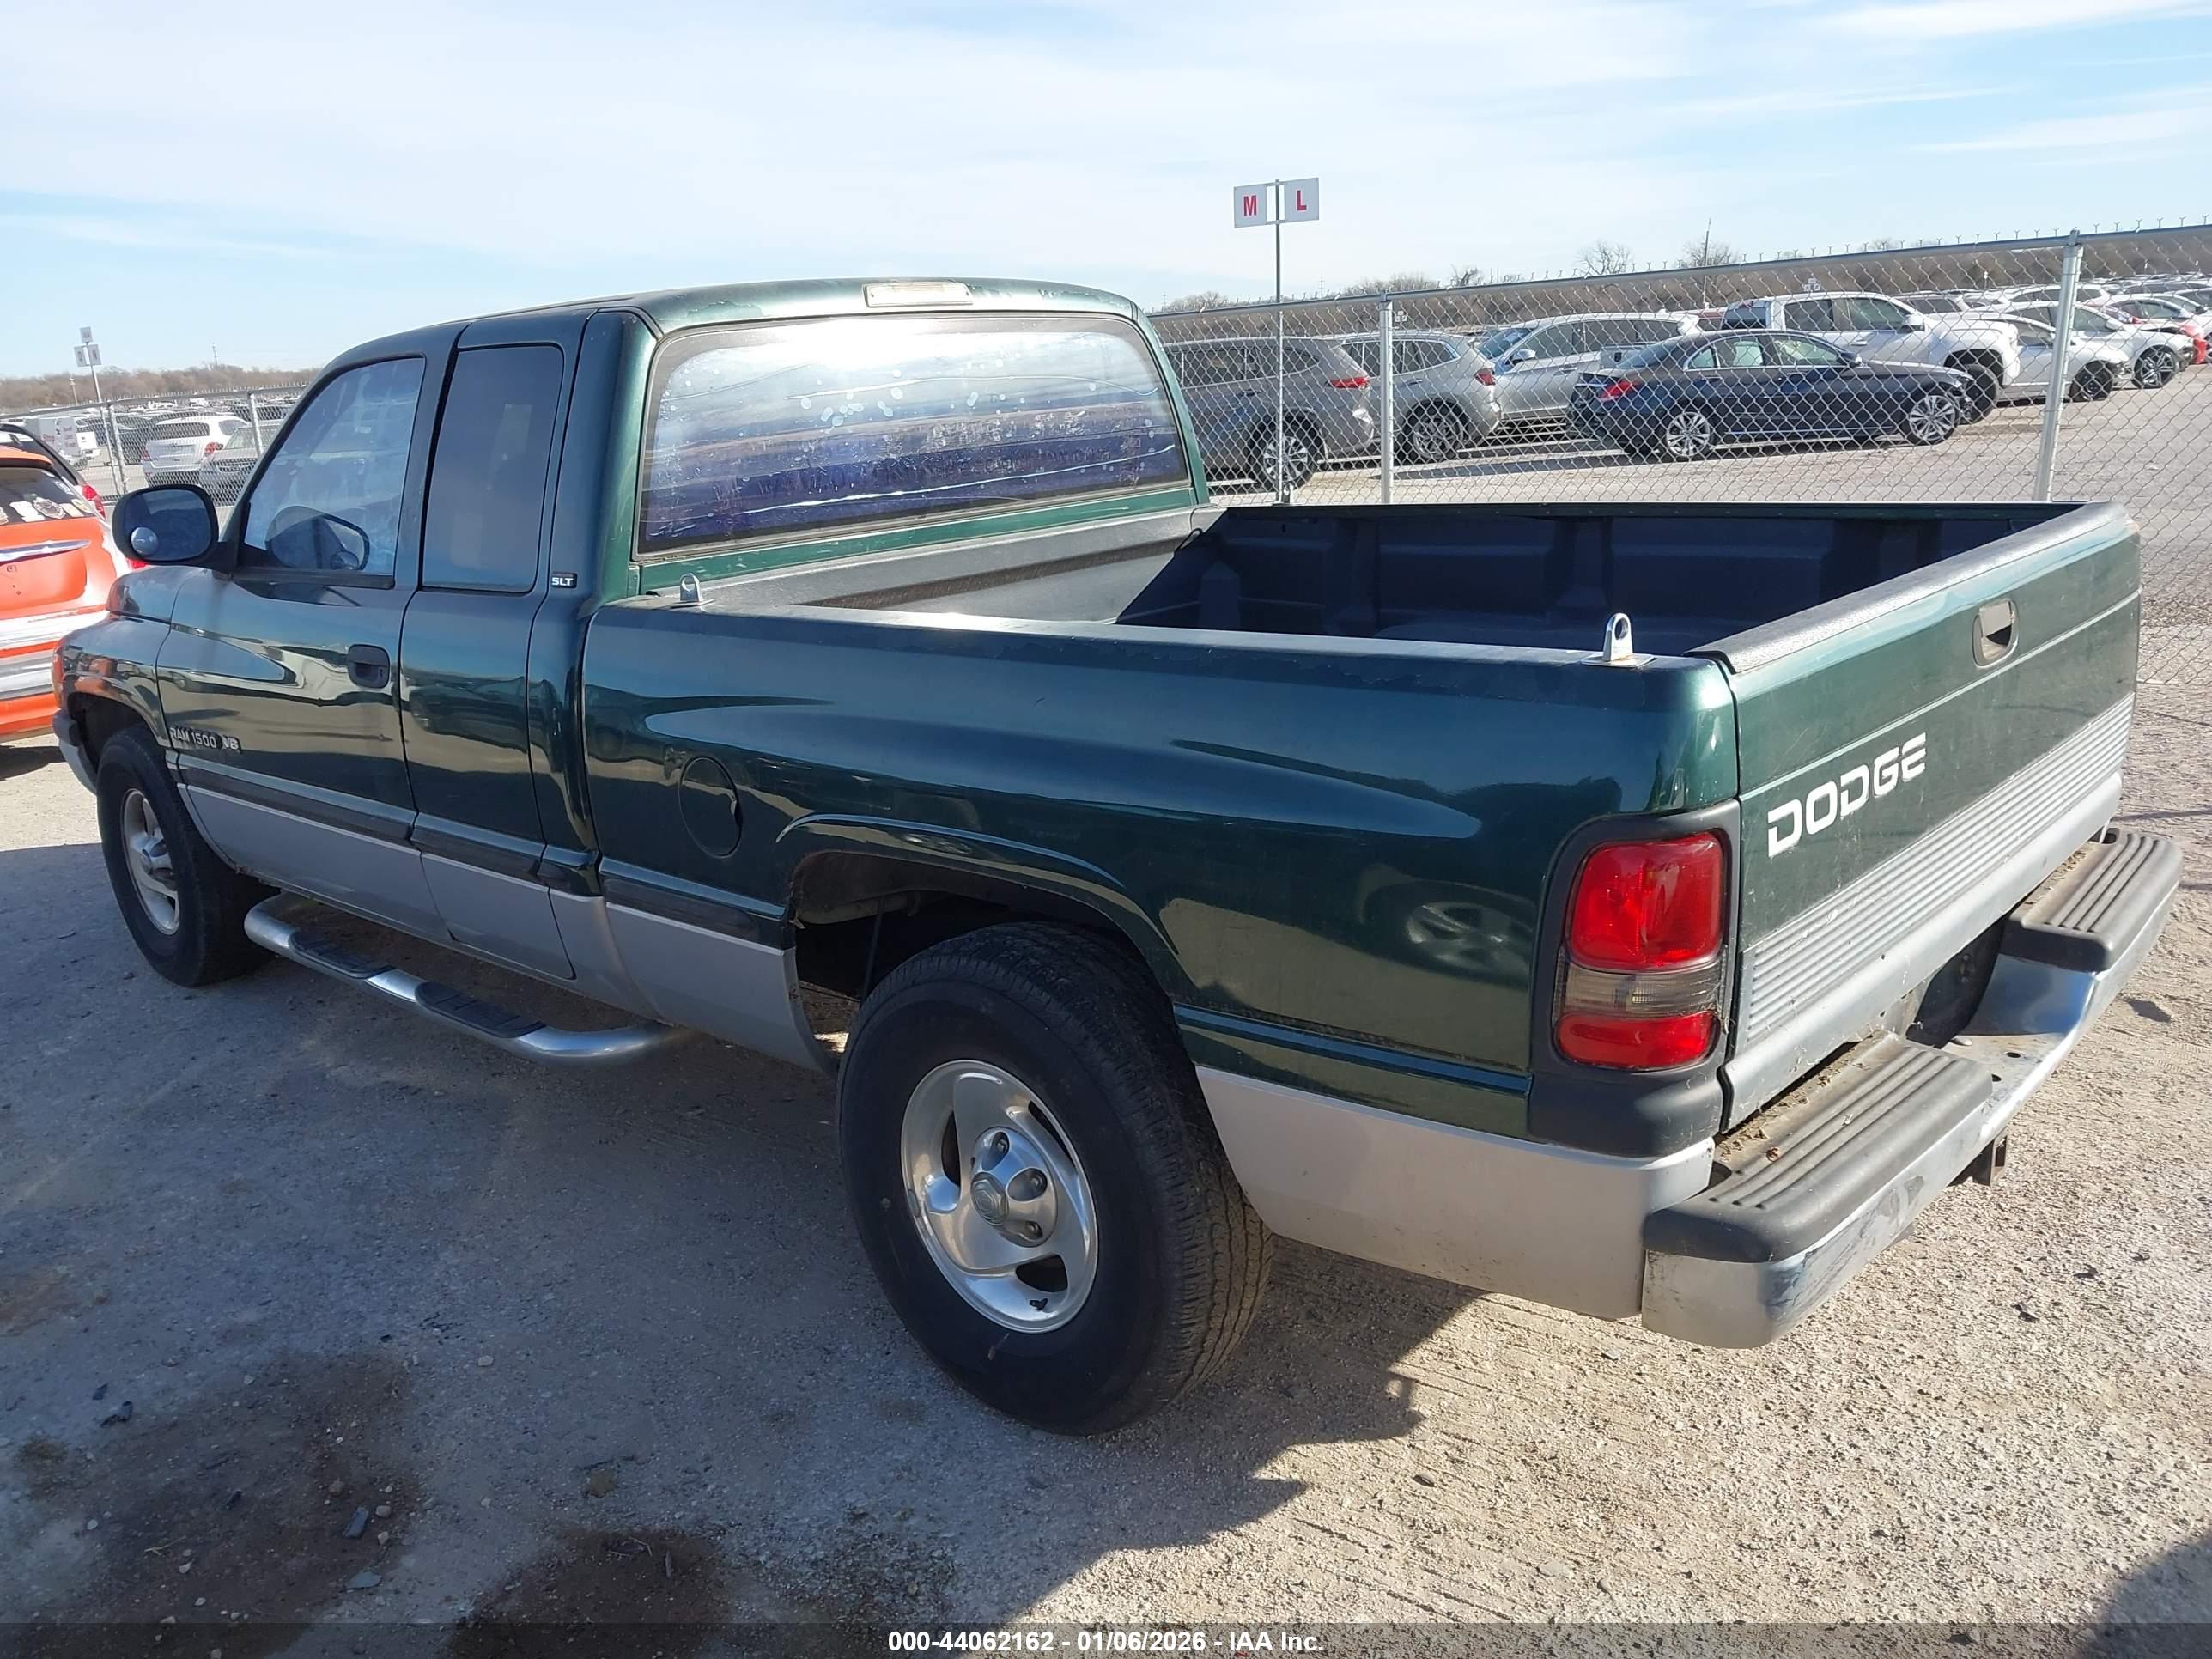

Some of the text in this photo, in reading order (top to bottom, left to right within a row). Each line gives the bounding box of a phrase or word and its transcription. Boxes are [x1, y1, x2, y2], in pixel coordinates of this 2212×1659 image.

[1243, 194, 1257, 216] M
[1297, 190, 1307, 211] L
[551, 576, 574, 586] SLT
[169, 727, 190, 743] RAM
[191, 732, 217, 749] 1500
[1767, 732, 1927, 858] DODGE
